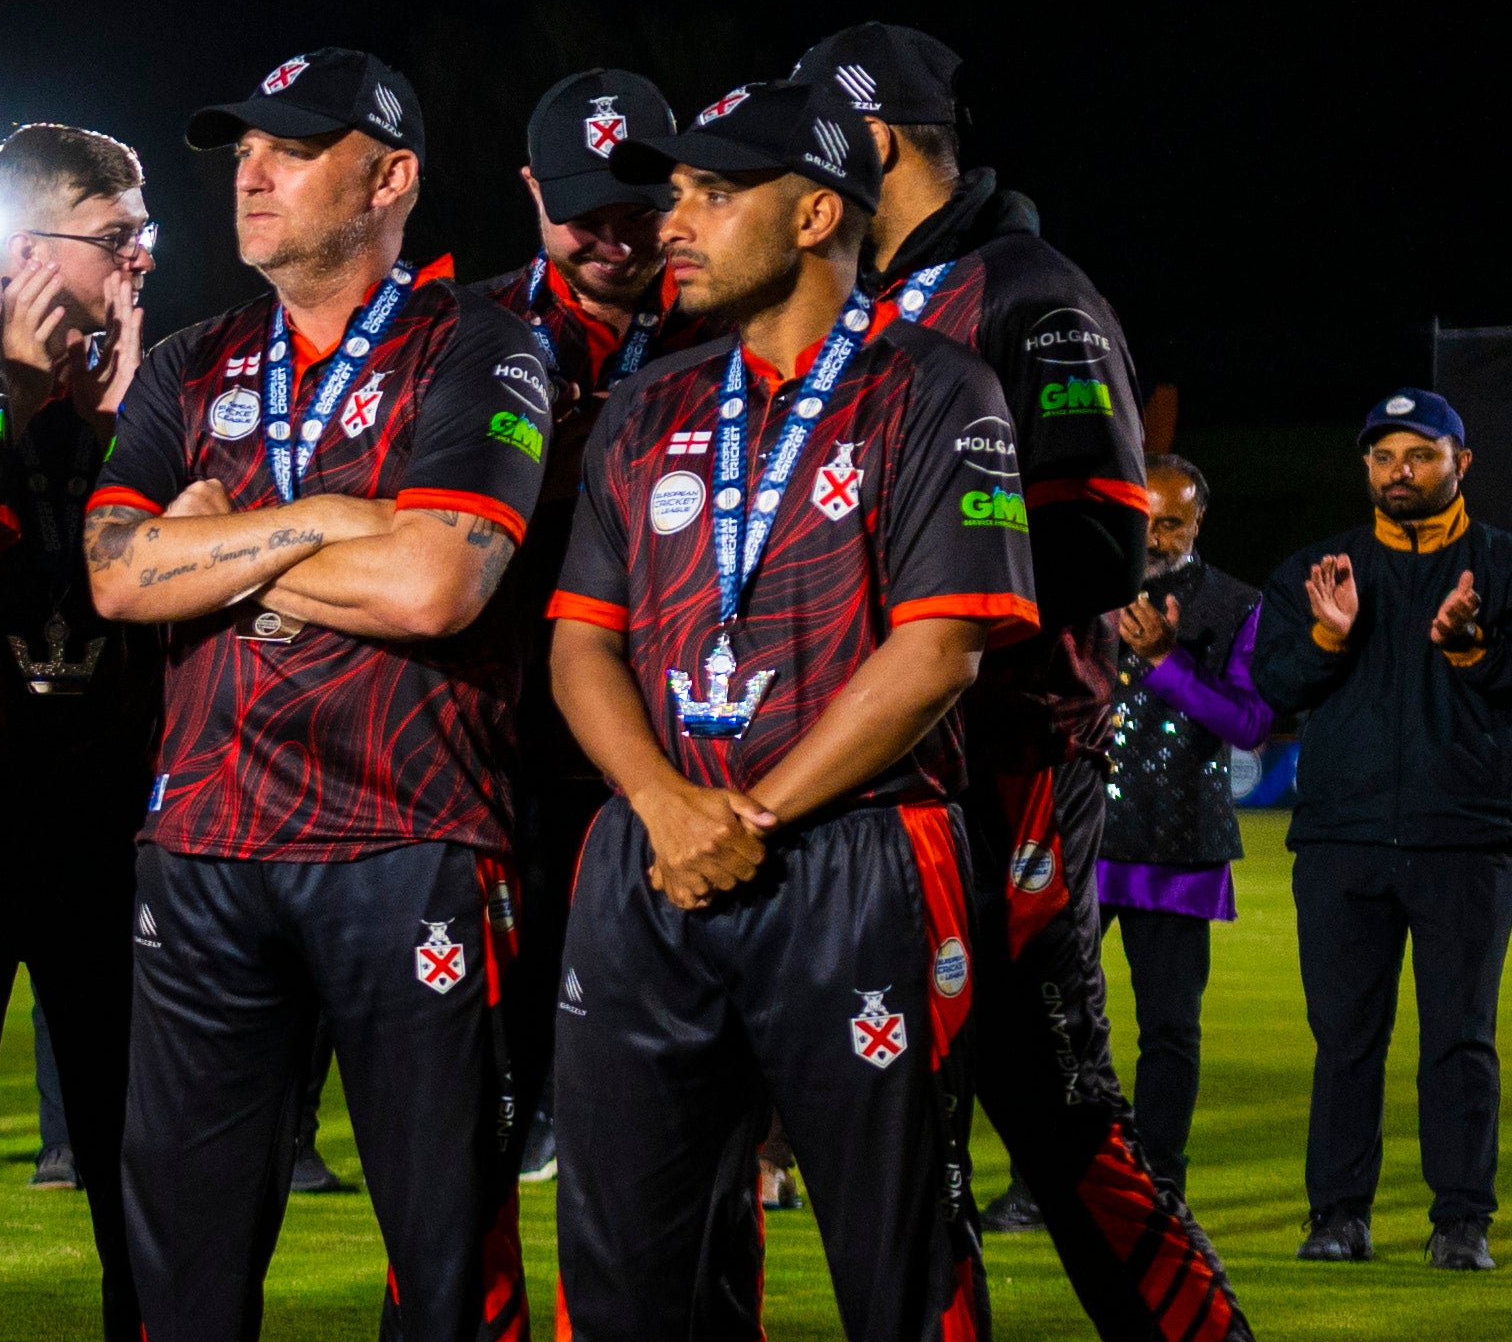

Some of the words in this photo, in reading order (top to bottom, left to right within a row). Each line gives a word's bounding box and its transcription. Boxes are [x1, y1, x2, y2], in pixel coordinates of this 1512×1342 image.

[368, 112, 404, 139] GRIZZLY
[805, 152, 847, 178] GRIZZLY
[362, 282, 393, 330] EUROPEAN
[369, 288, 401, 334] CRICKET
[812, 334, 846, 389] EUROPEAN
[1025, 327, 1111, 353] HOLGATE
[315, 361, 345, 413] EUROPEAN
[820, 338, 855, 391] CRICKET
[276, 365, 286, 416] CRICKET
[322, 363, 353, 415] CRICKET
[1040, 375, 1114, 411] GMI
[720, 425, 730, 480] EUROPEAN
[729, 423, 740, 480] CRICKET
[769, 424, 799, 481] EUROPEAN
[775, 425, 807, 482] CRICKET
[955, 436, 1016, 457] HOLGA
[654, 490, 699, 499] EUROPEAN
[654, 498, 699, 508] CRICKET
[661, 507, 691, 515] LEAGUE
[204, 540, 261, 569] Jimmy
[268, 526, 325, 553] Bobby
[729, 516, 739, 573] CRICKET
